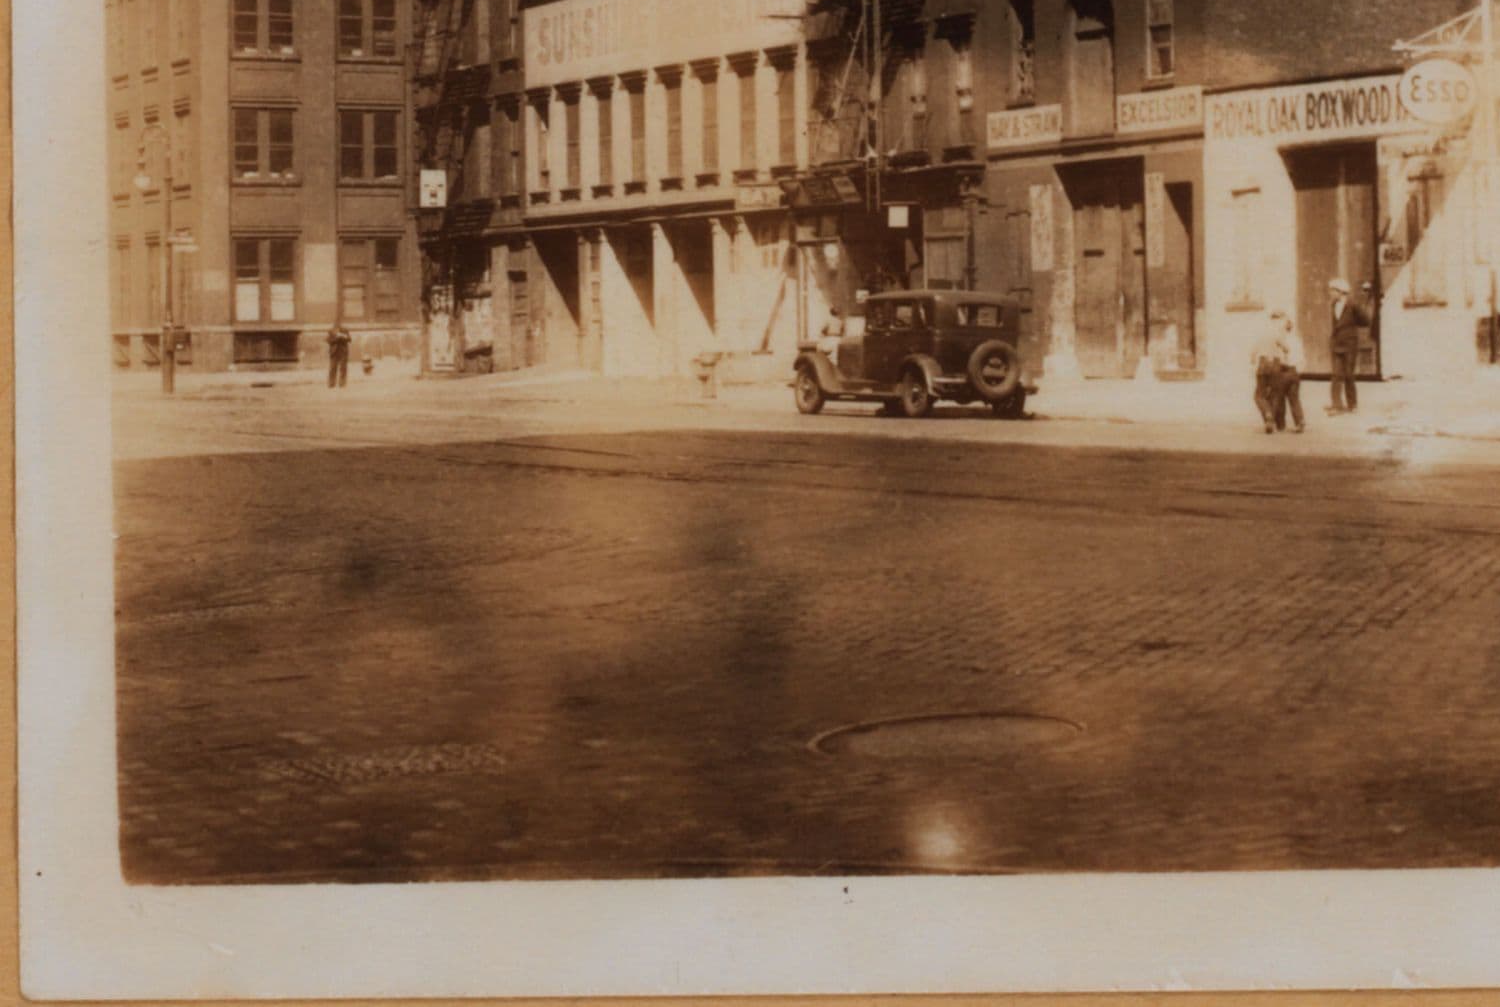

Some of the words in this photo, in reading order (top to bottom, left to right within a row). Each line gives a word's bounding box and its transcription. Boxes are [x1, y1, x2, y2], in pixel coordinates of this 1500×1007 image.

[1211, 99, 1263, 138] ROYAL
[1267, 95, 1301, 133] OAK
[1306, 85, 1391, 130] BOXWOOD
